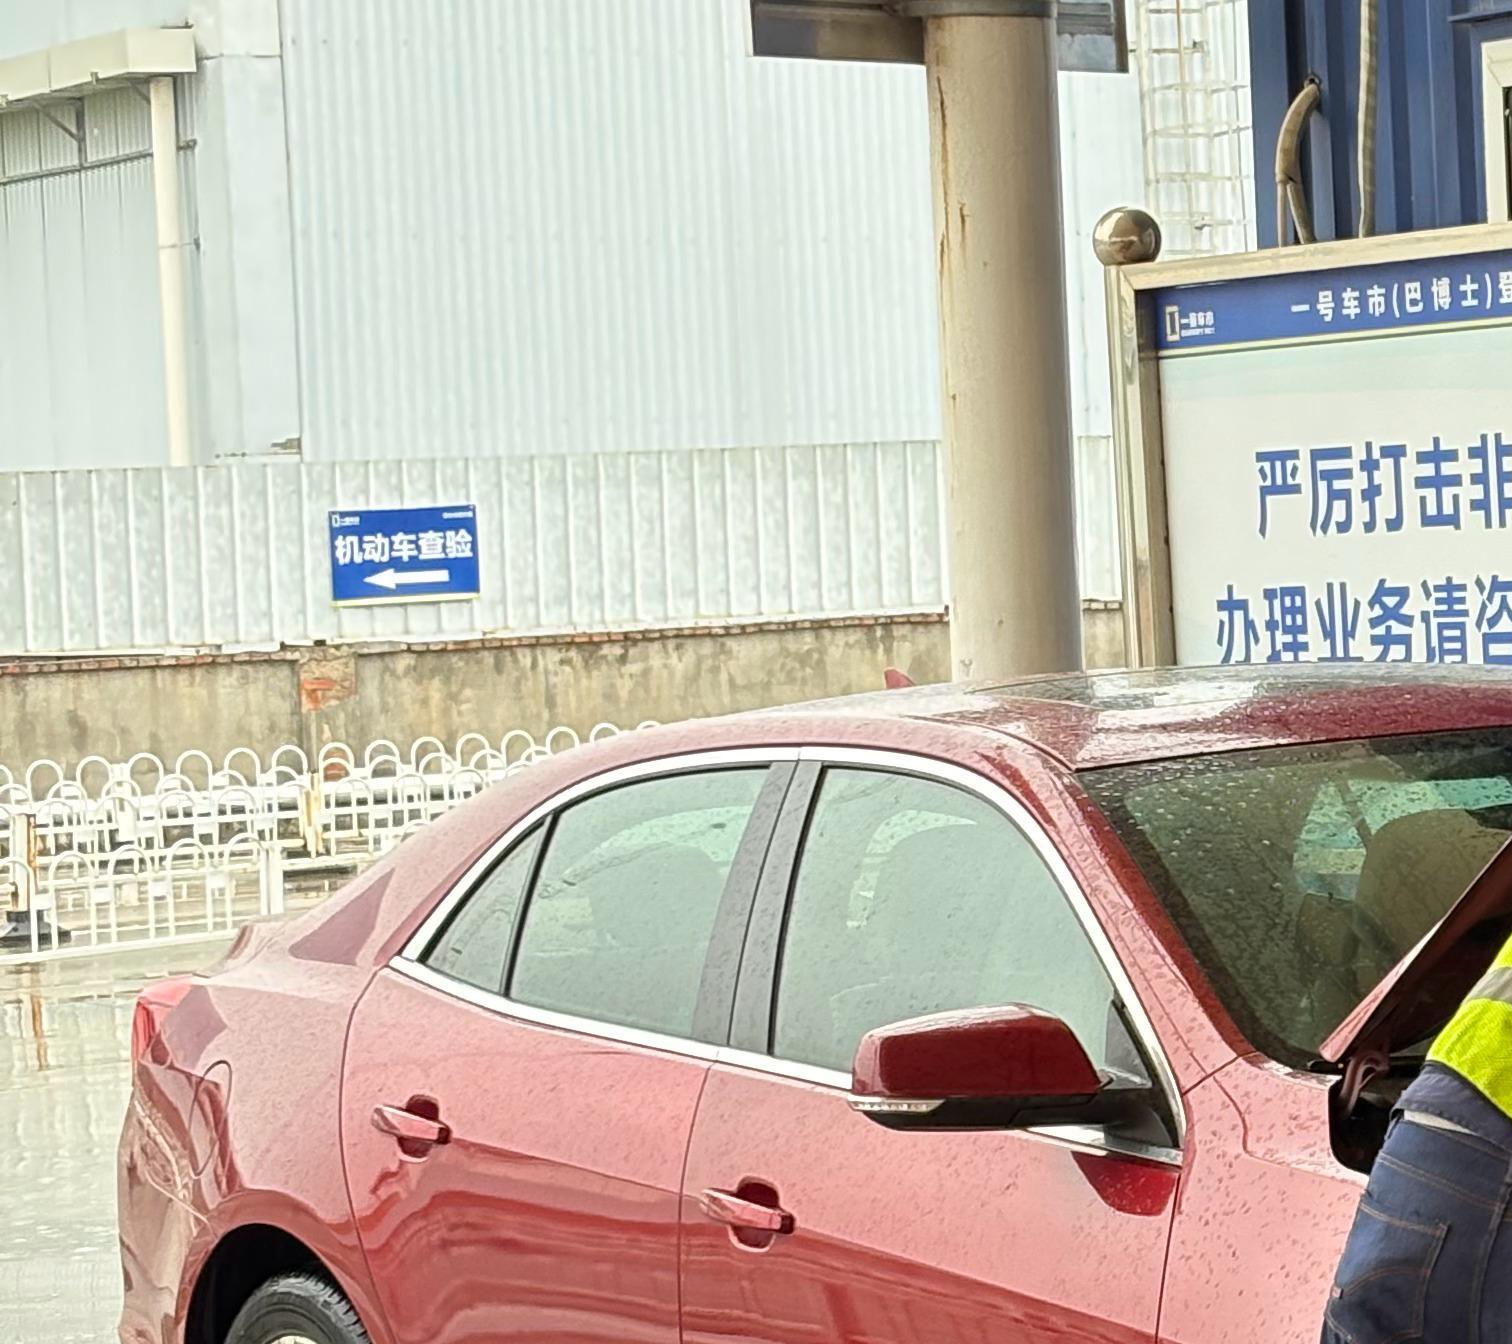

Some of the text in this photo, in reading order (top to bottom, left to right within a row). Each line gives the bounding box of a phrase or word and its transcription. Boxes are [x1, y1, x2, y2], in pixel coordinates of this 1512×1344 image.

[334, 528, 474, 565] 机动车查验
